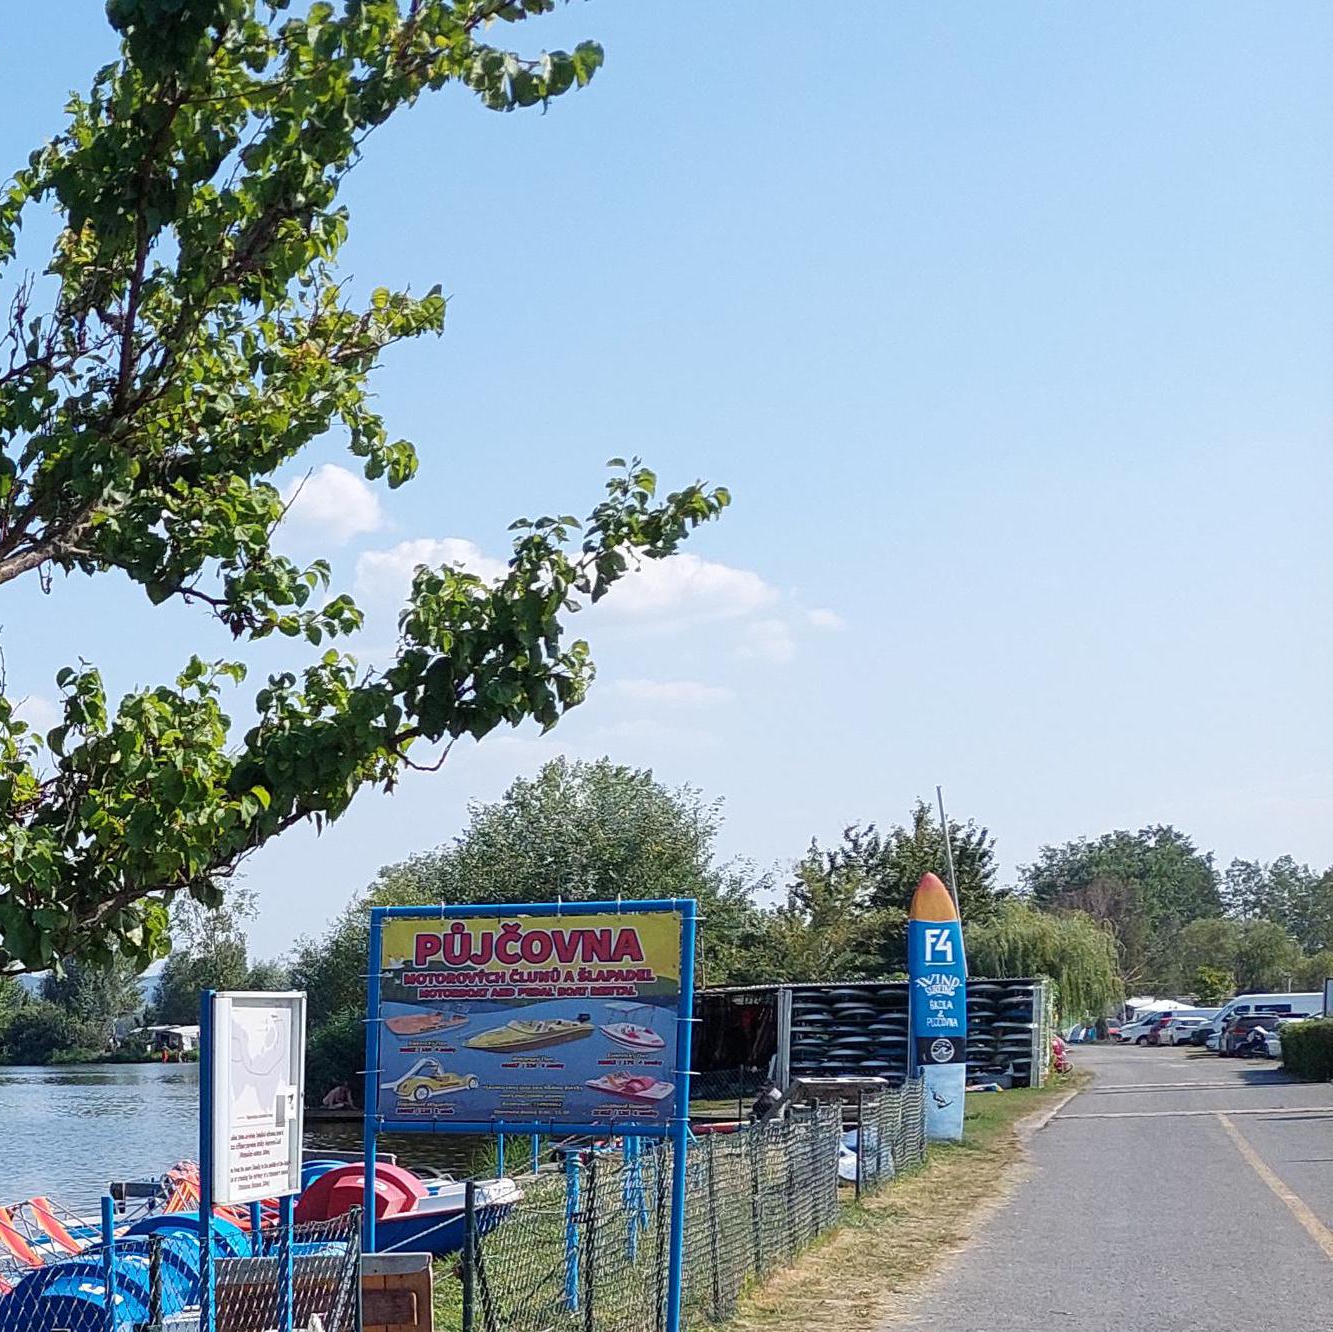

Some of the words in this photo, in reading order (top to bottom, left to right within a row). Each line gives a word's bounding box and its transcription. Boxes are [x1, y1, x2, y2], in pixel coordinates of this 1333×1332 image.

[414, 921, 644, 966] PŮJČOVNA
[925, 929, 953, 962] F4
[403, 967, 506, 985] MOTOROVÝCH
[508, 966, 561, 984] ČLUNŮ
[563, 969, 575, 983] A
[577, 966, 656, 982] ŠLAPADEL
[915, 973, 963, 988] WIND
